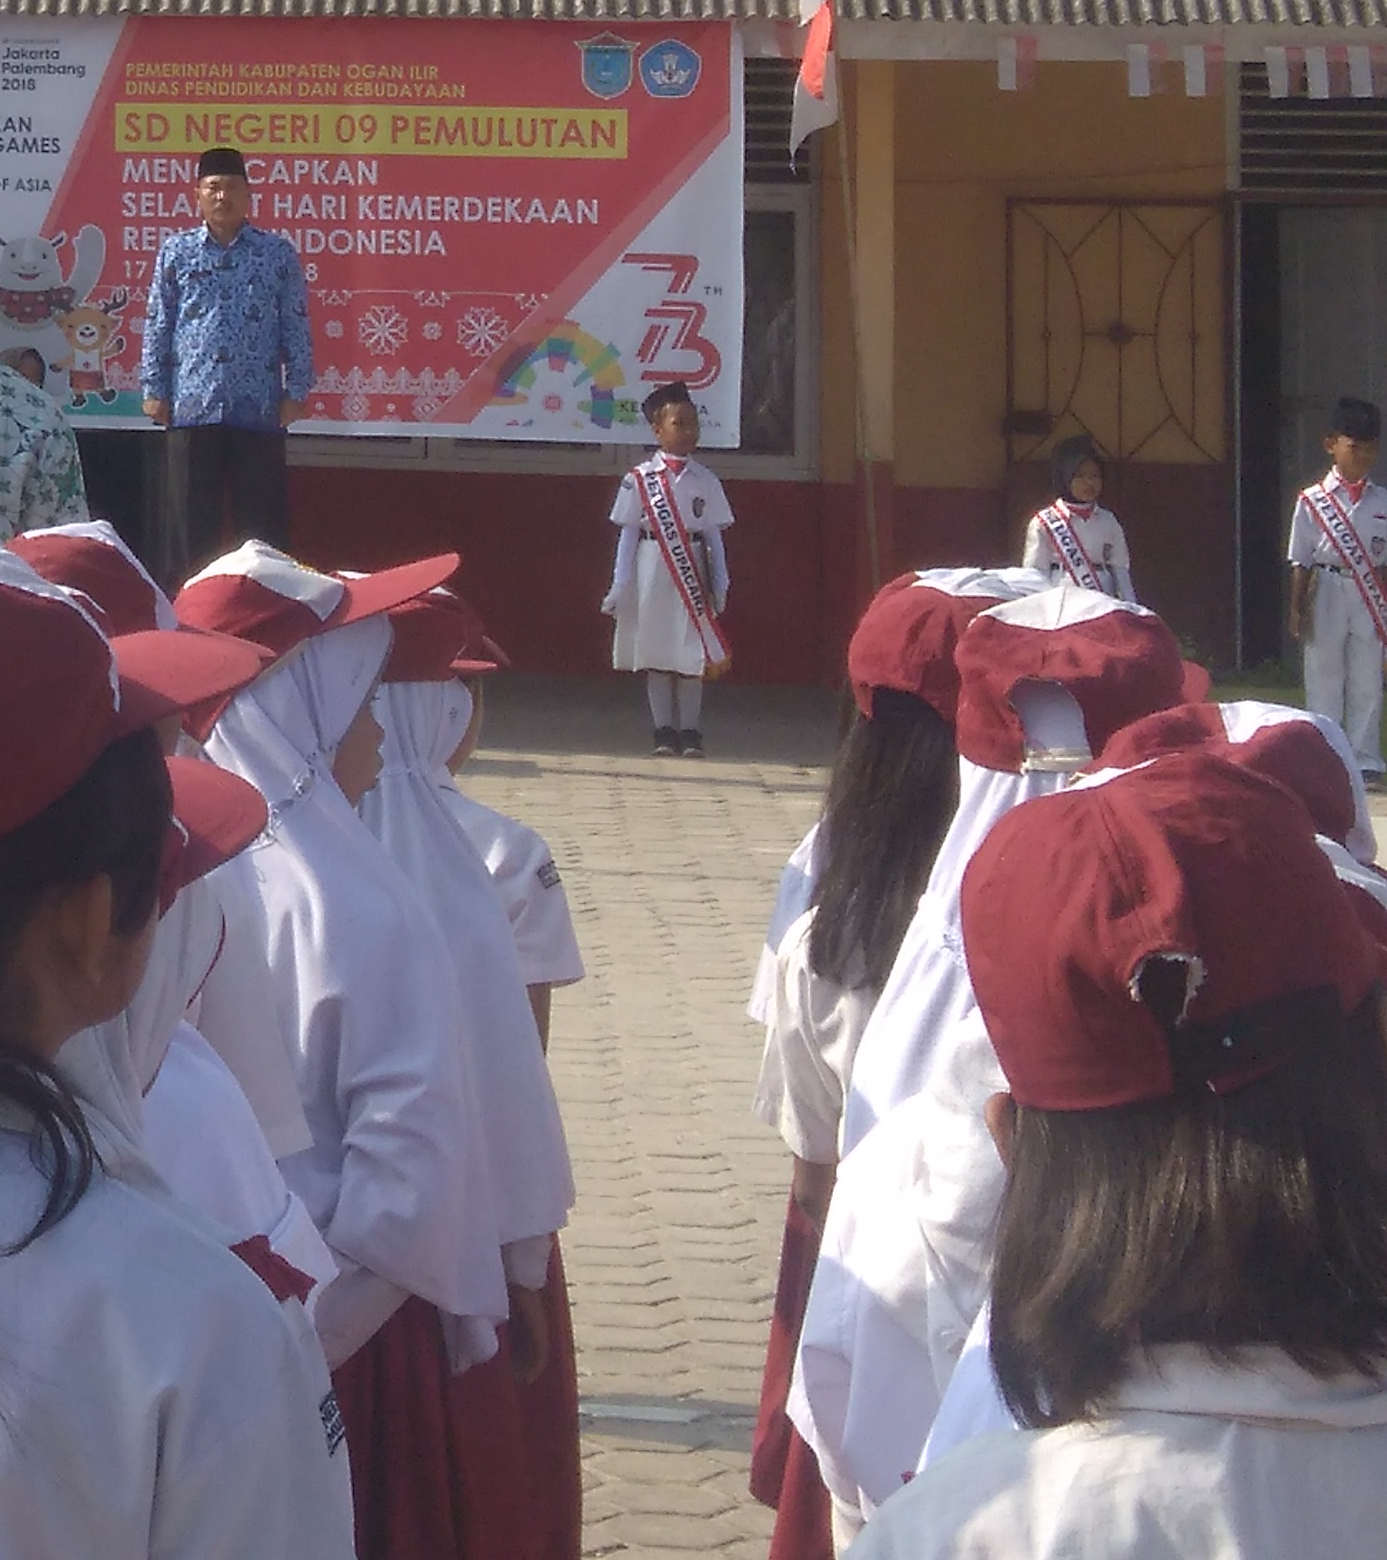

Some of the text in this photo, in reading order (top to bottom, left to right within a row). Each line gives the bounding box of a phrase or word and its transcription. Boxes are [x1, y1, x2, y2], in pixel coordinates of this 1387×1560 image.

[2, 47, 60, 60] Jakarta
[2, 62, 86, 77] Palembang
[126, 63, 438, 81] PEMERINTAH KABUPATEN OGAN ILIR
[2, 78, 36, 91] 2018
[125, 80, 466, 99] DINAS PENDIDIKAN DAN KEBUDAYAAN
[125, 113, 618, 150] SD NEGERI 09 PEMULUTAN
[122, 159, 379, 186] MENCAPKAN
[14, 178, 52, 192] ASIA
[122, 193, 599, 225] SELAT HARI KEMERDEKAAN
[272, 228, 446, 256] NDONESIA
[124, 260, 148, 280] 17
[704, 286, 722, 296] TH
[1315, 491, 1364, 566] PETUGAS
[645, 470, 705, 618] PETUGAS UPACARA
